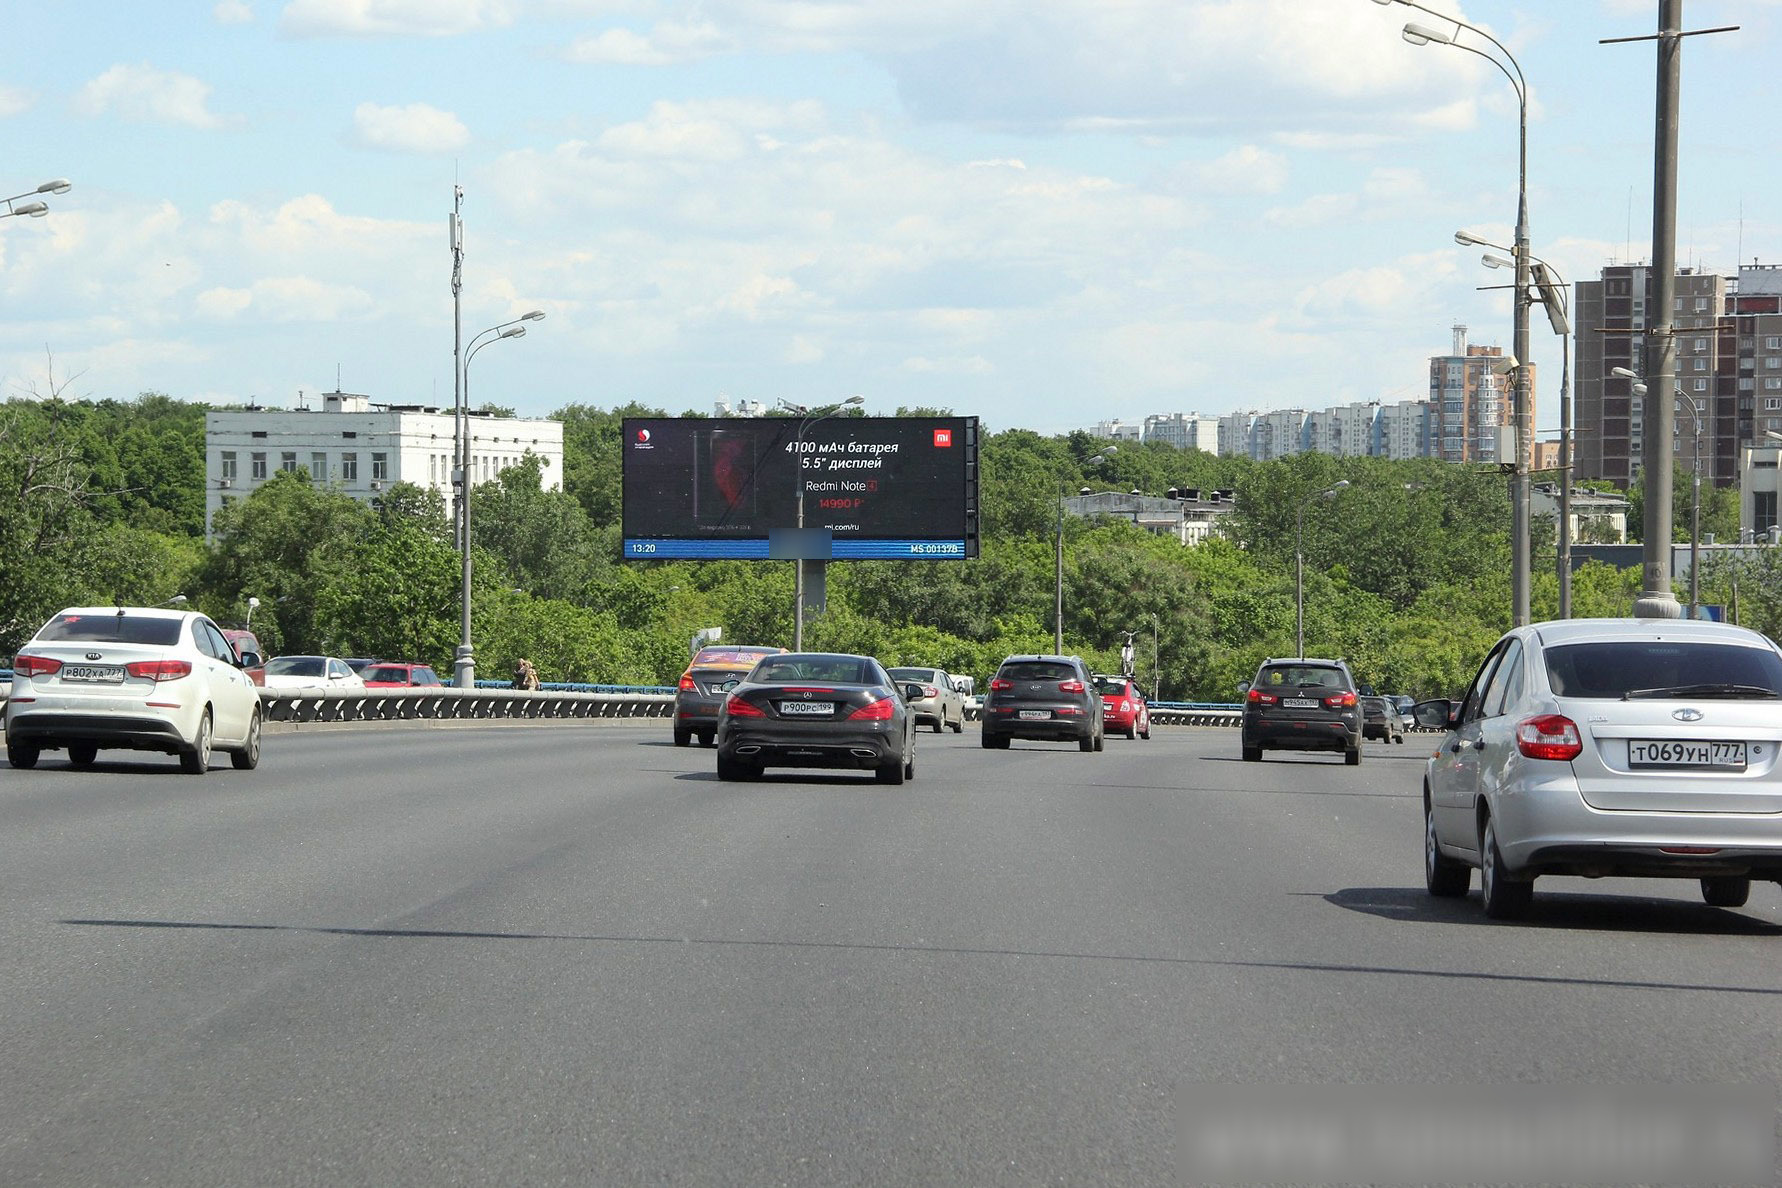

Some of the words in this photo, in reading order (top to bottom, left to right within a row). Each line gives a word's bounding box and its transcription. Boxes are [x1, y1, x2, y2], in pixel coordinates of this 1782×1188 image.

[785, 441, 816, 453] 4100
[818, 441, 845, 453] мАч
[847, 441, 899, 457] батарея
[828, 457, 882, 471] дисплей
[805, 480, 838, 491] Redmi
[841, 480, 867, 491] Note
[820, 499, 852, 509] 14990
[632, 544, 656, 553] 13:20
[910, 544, 924, 553] MS
